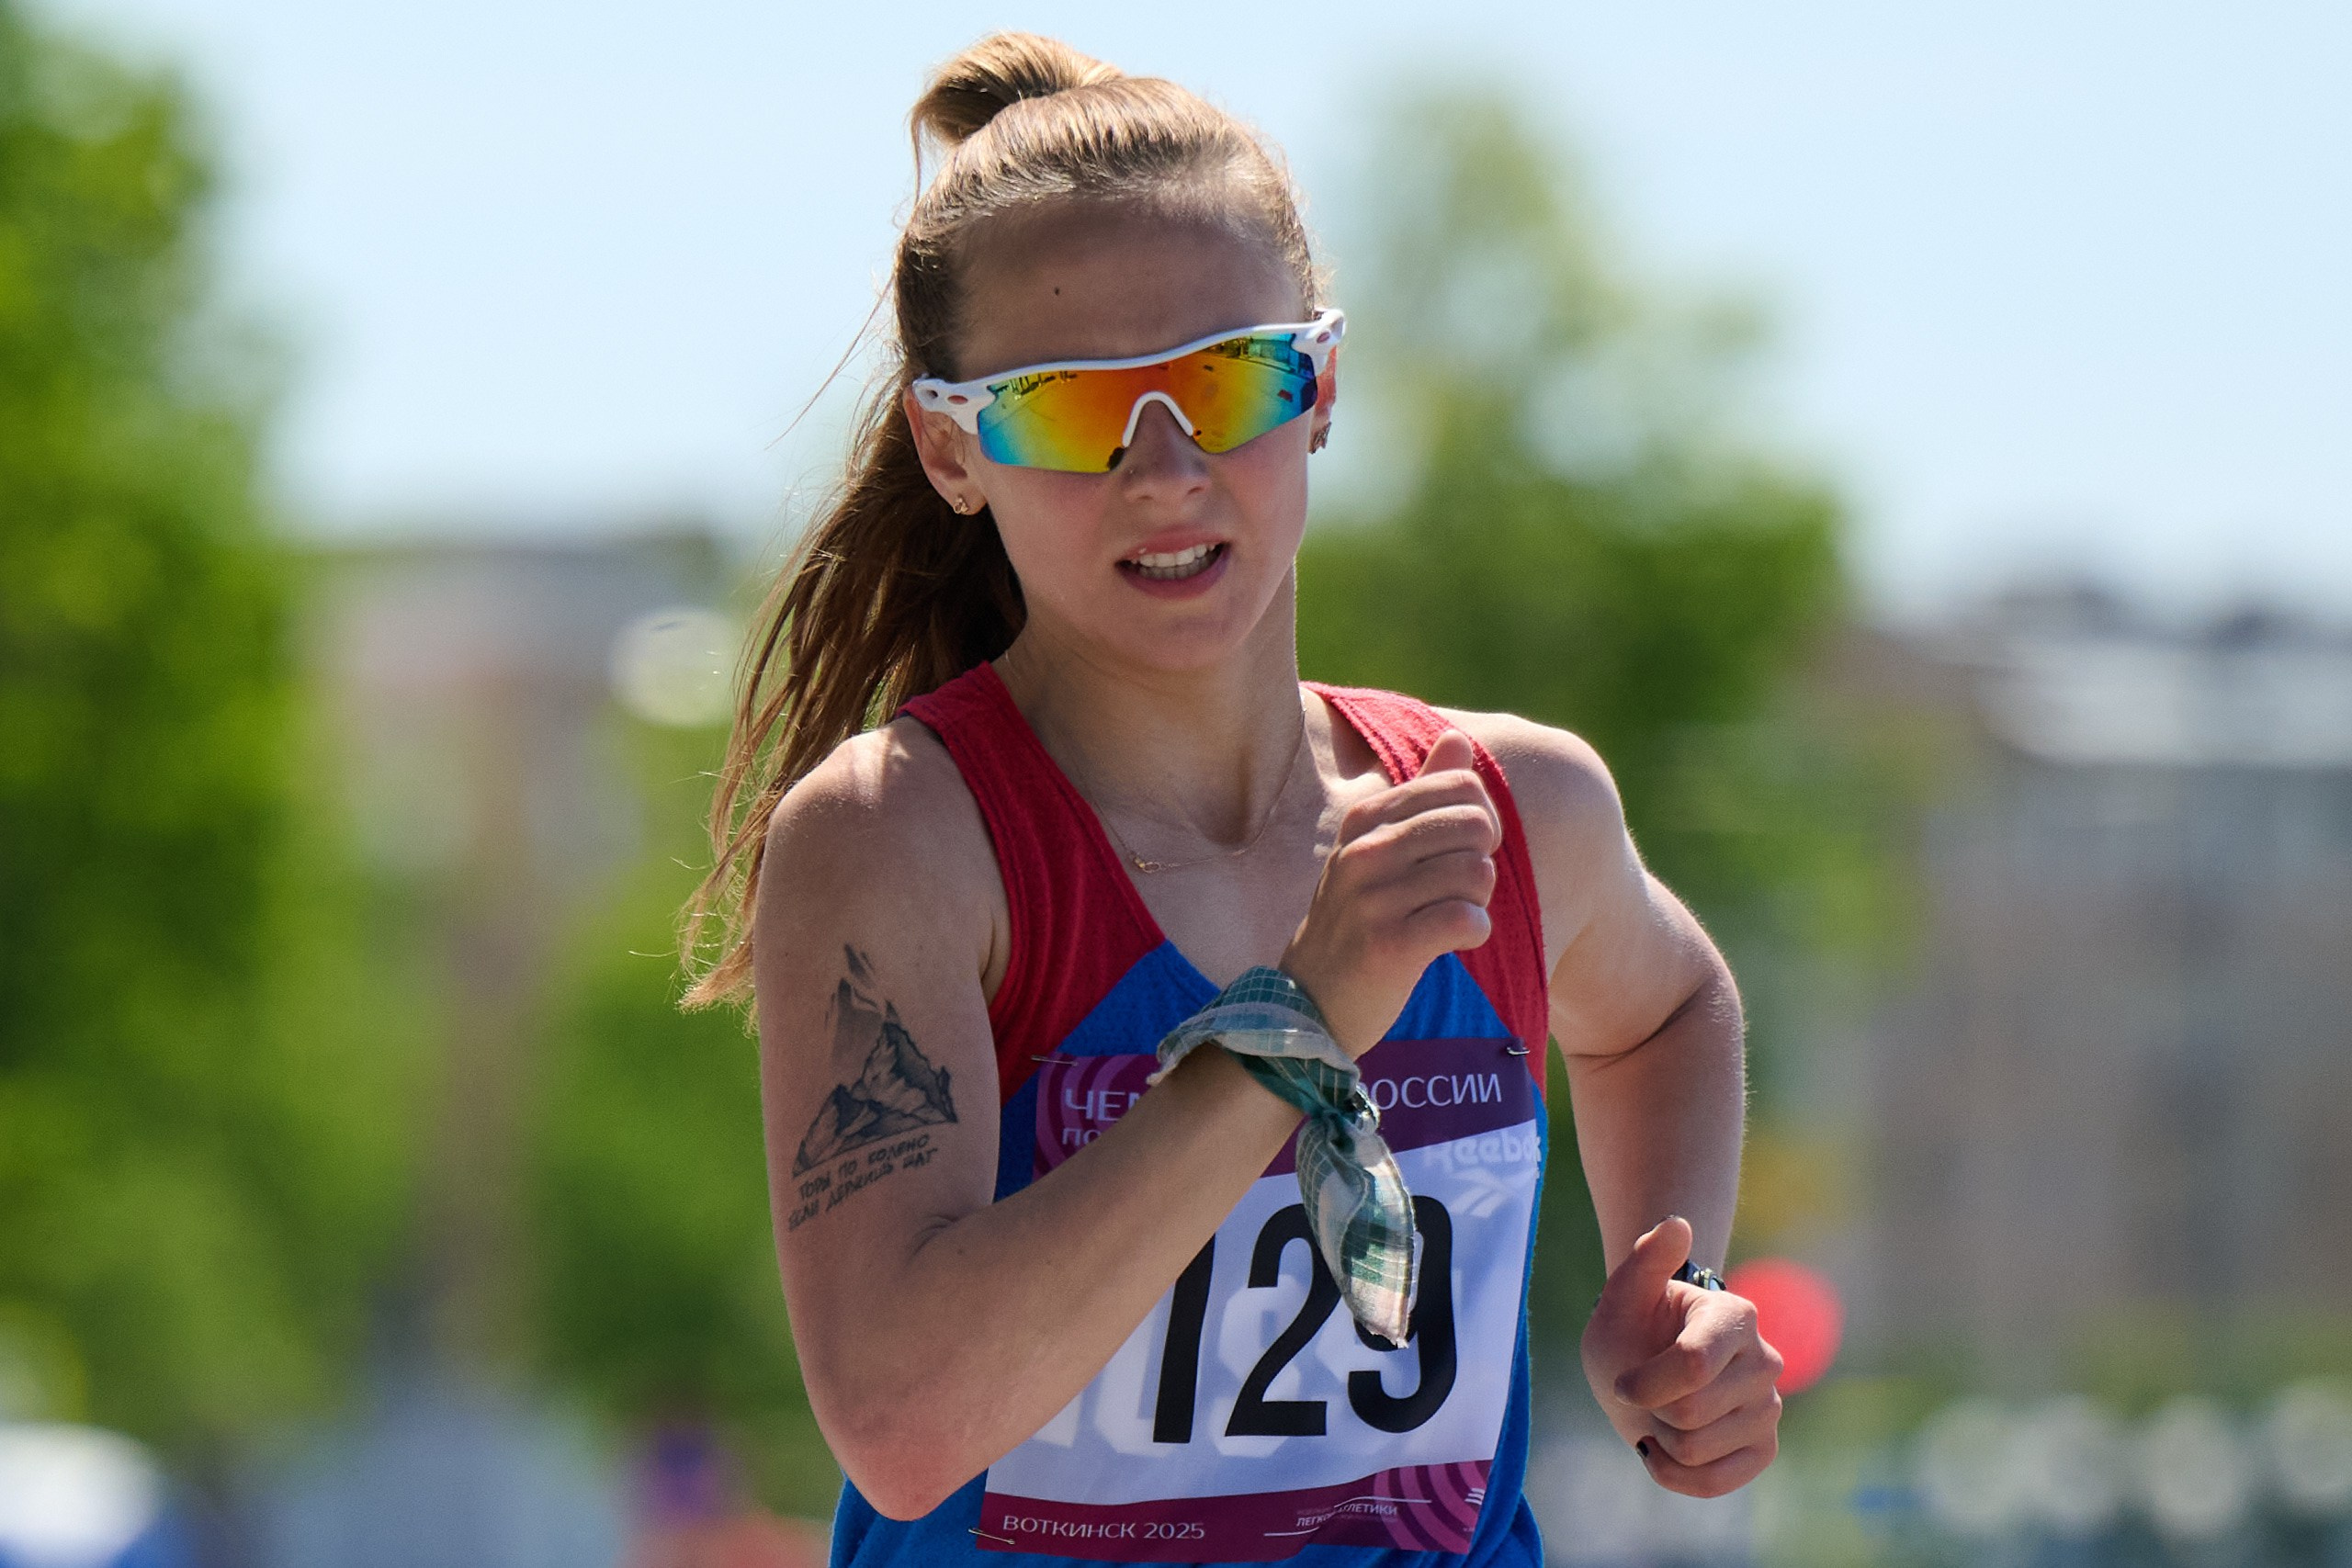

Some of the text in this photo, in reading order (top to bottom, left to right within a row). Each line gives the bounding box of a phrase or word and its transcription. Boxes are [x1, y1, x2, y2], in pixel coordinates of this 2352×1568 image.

[1359, 1073, 1502, 1111] ОССИИ
[1152, 1194, 1458, 1444] 129
[1002, 1515, 1205, 1540] ВОТКИНСК 2025
[1296, 1512, 1336, 1527] ЛЕГКО
